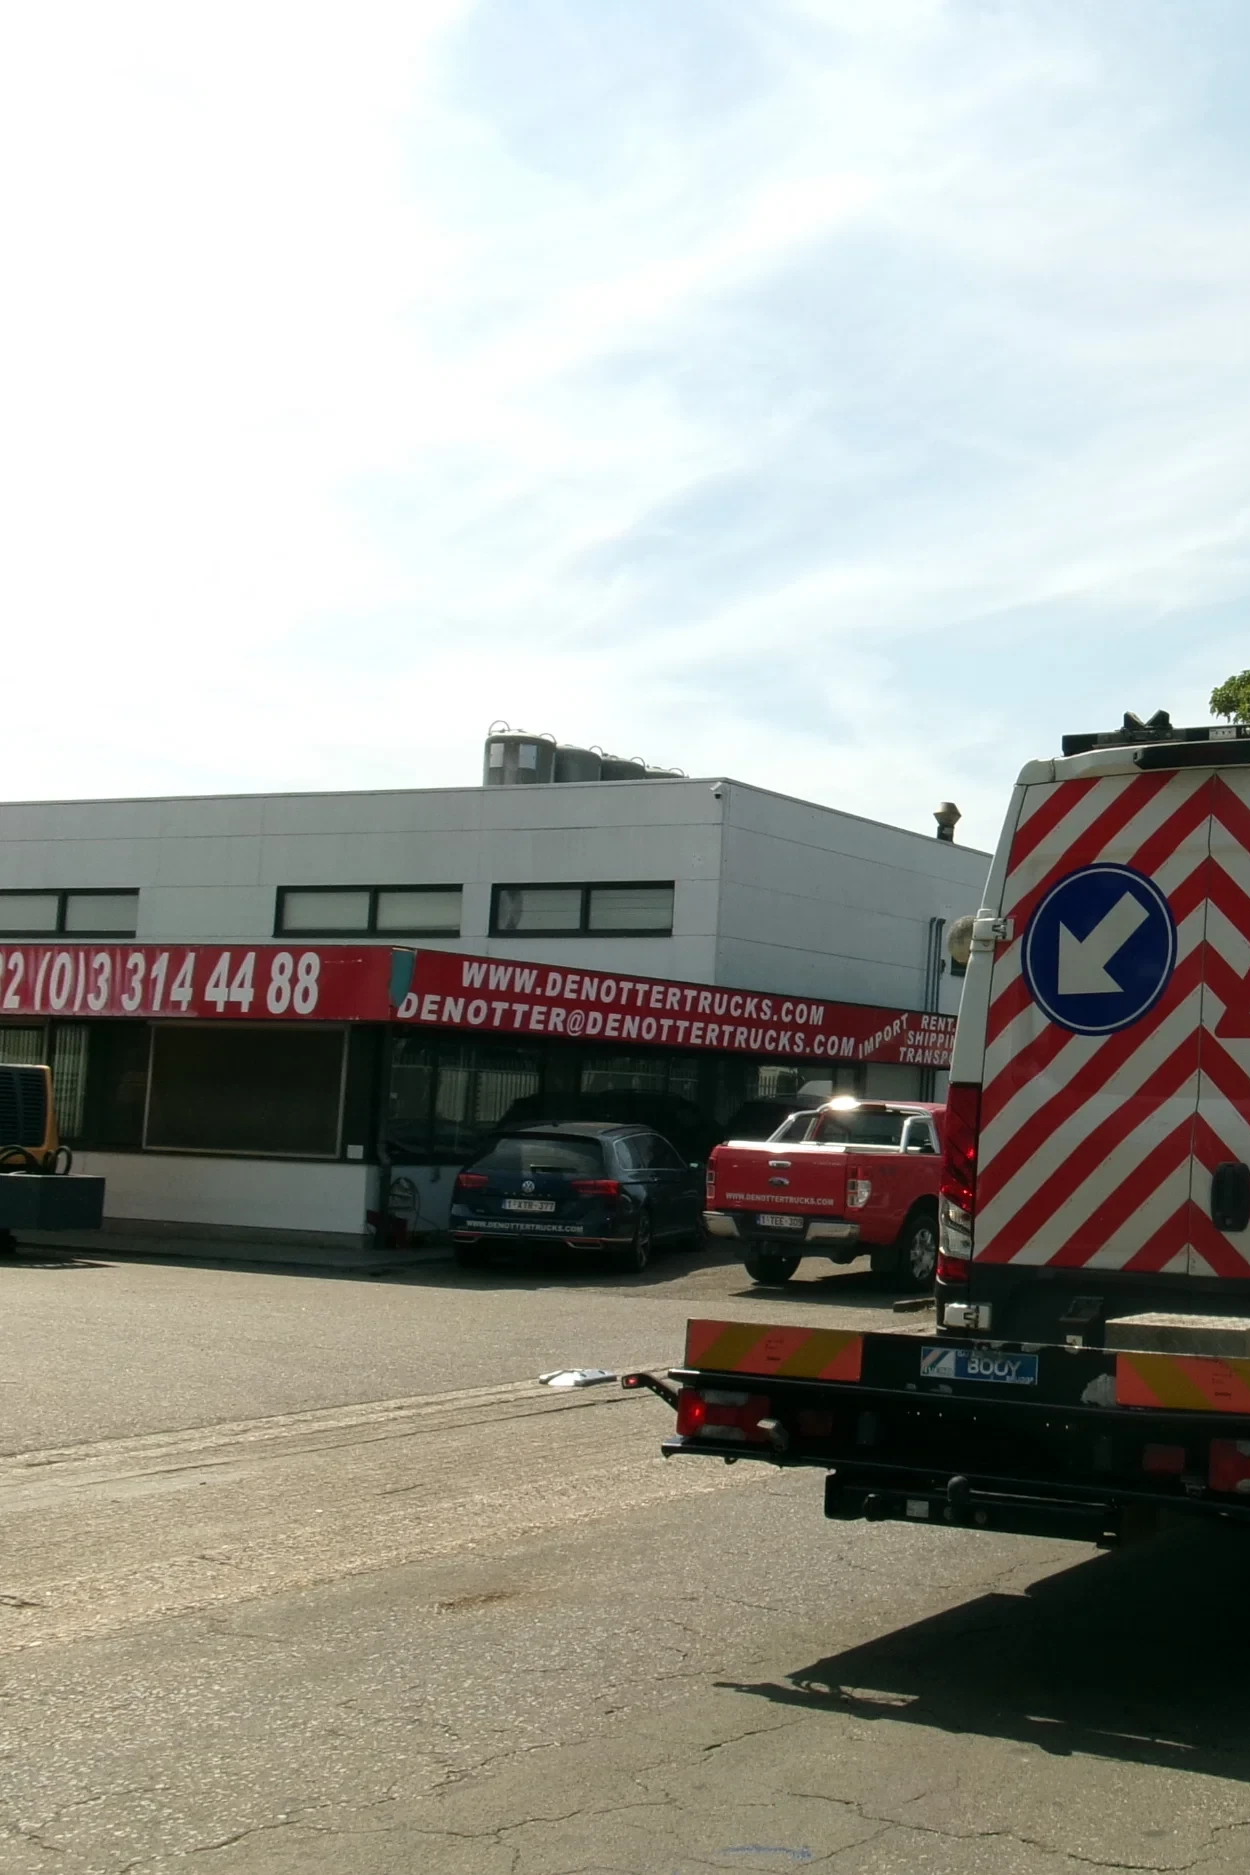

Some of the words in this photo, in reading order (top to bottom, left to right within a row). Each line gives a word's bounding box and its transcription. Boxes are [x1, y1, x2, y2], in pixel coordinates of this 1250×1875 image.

[0, 952, 25, 1008] 2
[121, 951, 196, 1012] 314
[205, 951, 256, 1013] 44
[267, 951, 320, 1015] 88
[462, 961, 825, 1026] WWW.DENOTTERTRUCKS.COM
[397, 992, 855, 1057] DENOTTER@DENOTTERTRUCKS.COM
[859, 1013, 908, 1059] IMPORT
[466, 1220, 584, 1233] WWW.DENOTTERTRUCKS.COM
[726, 1192, 834, 1206] WWW.DENOTTERTRUCKS.COM
